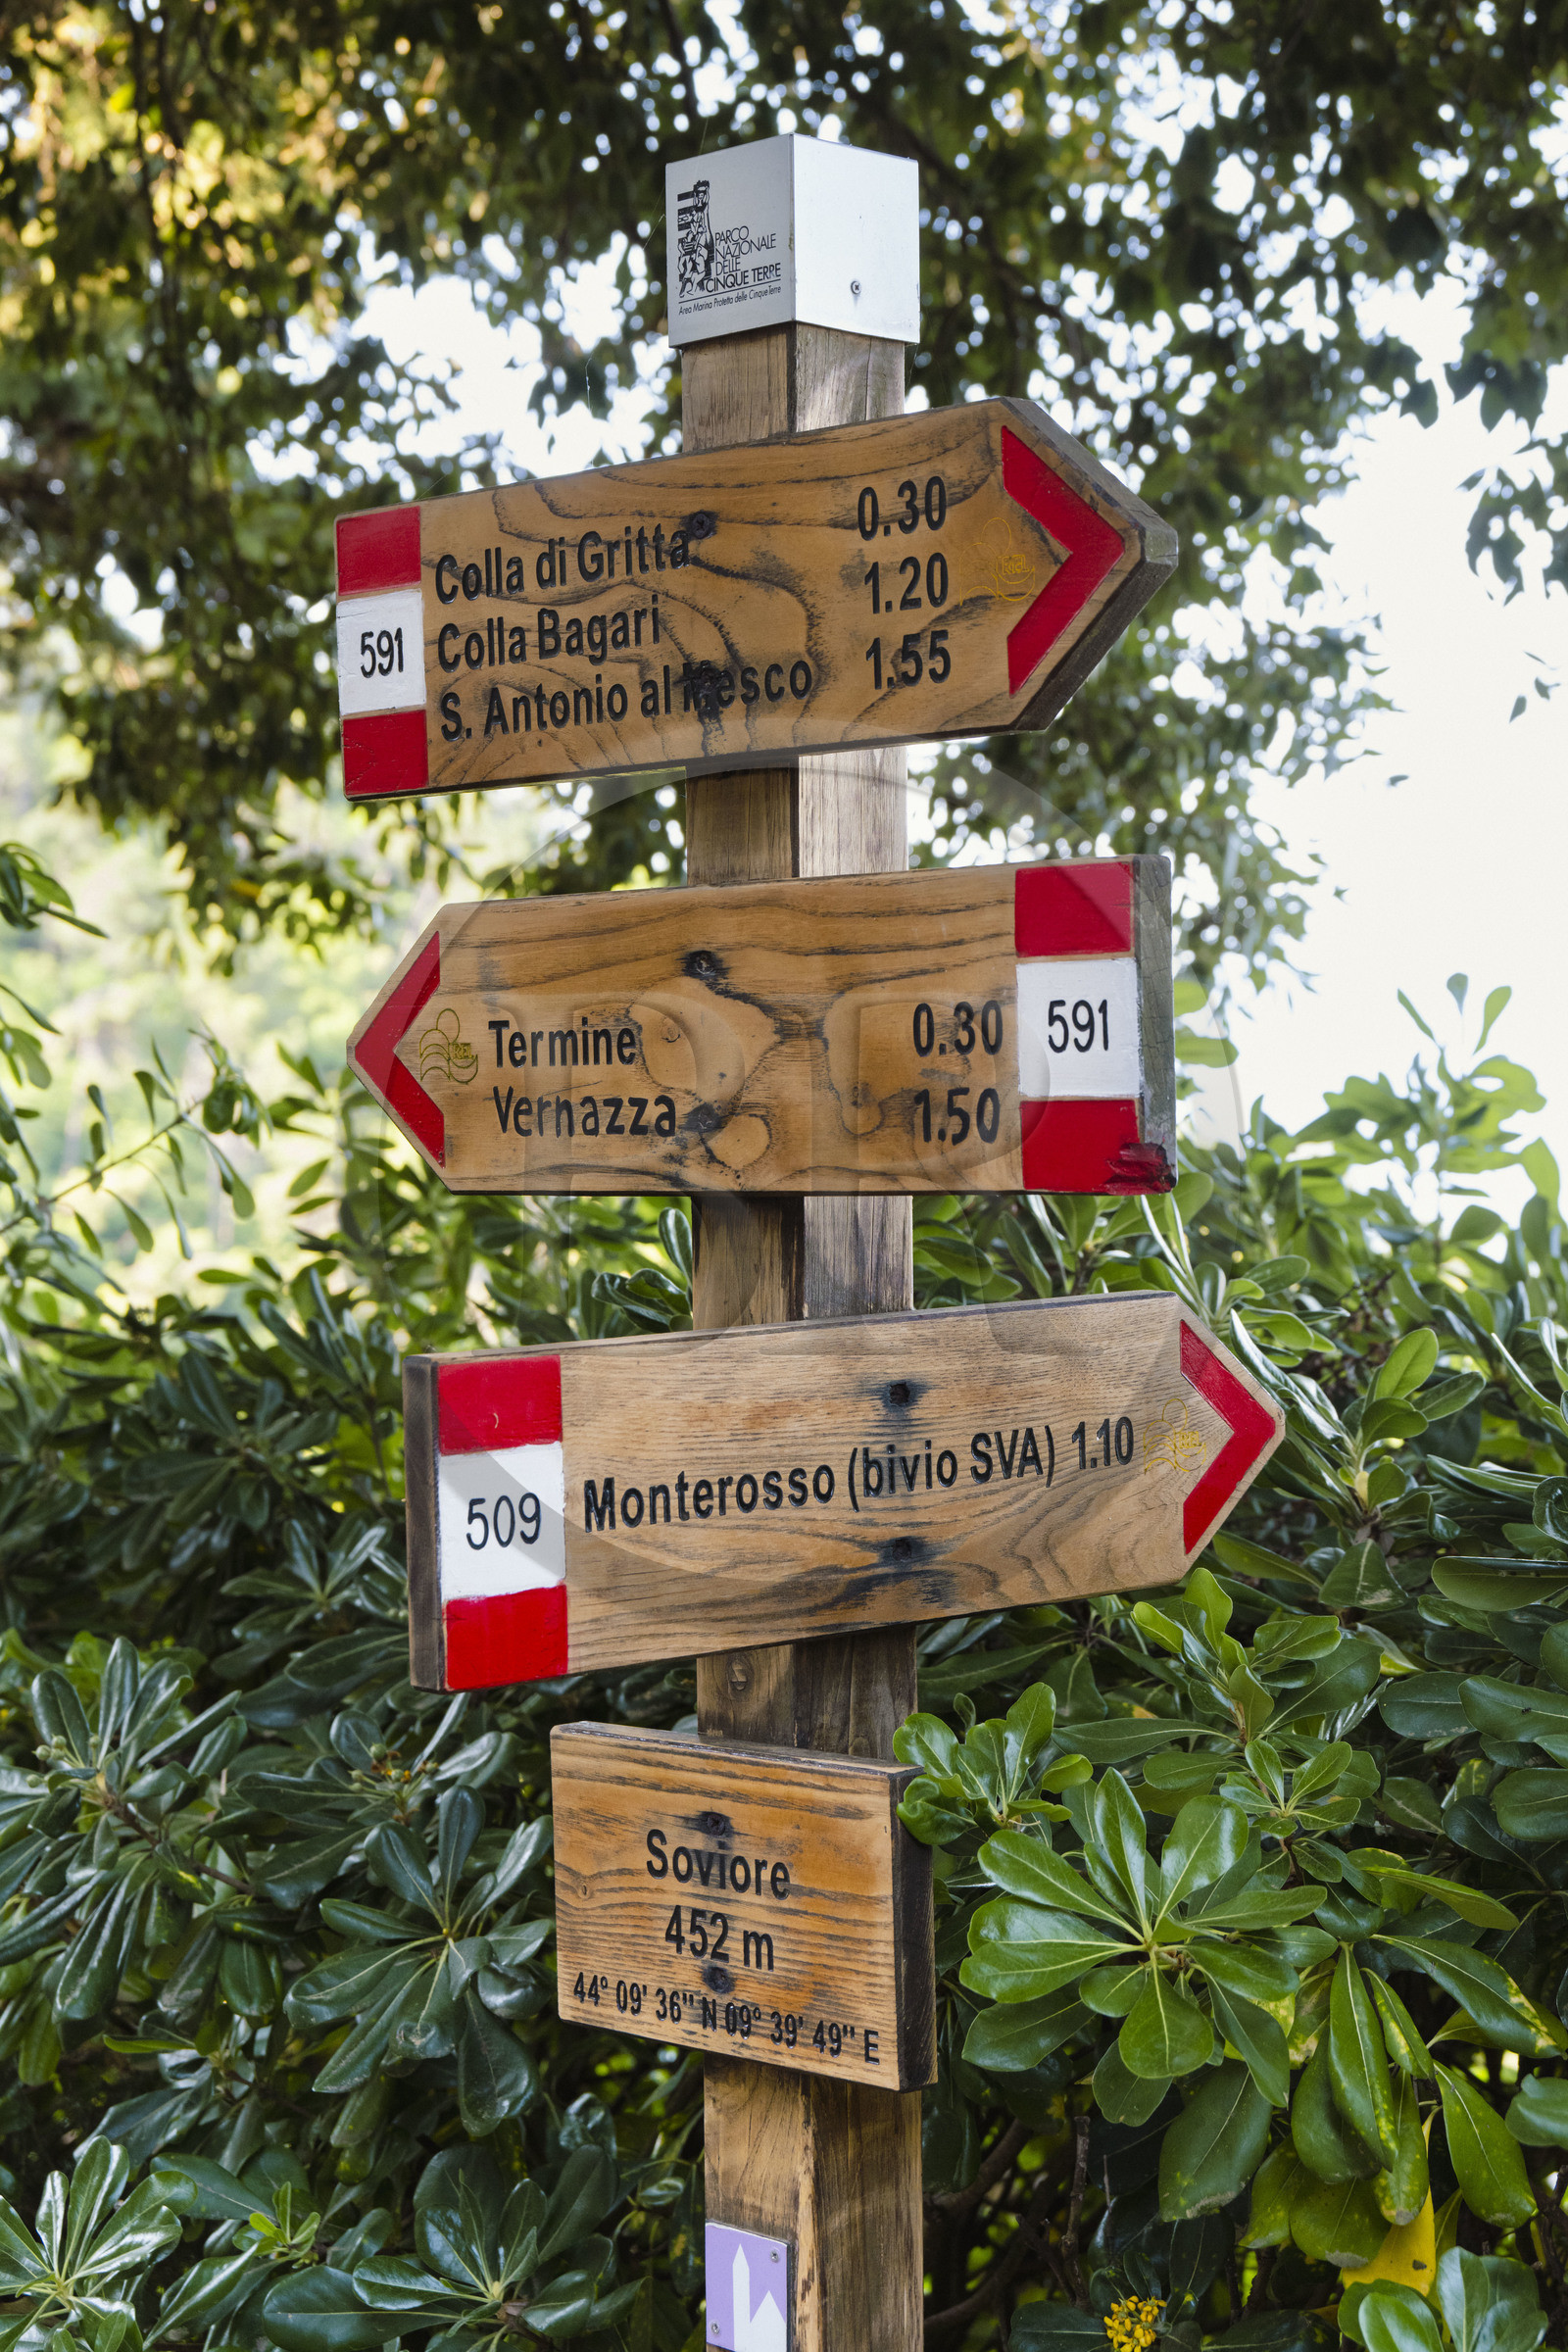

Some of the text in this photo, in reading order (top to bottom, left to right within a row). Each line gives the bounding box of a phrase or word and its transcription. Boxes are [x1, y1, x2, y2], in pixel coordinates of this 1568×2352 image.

[714, 225, 750, 247] PARCO
[714, 233, 777, 262] NAZIONALE
[715, 256, 741, 276] DELLE
[678, 306, 692, 316] Area
[693, 302, 712, 312] Marina
[713, 296, 733, 308] Protetta
[734, 292, 748, 303] delle
[749, 289, 768, 300] Cinque
[705, 263, 781, 293] CINQUE TERRE
[434, 475, 947, 605] Colla di Gritta 0.30
[437, 552, 949, 673] Colla Bagari 1.20
[360, 626, 404, 679] 591
[439, 692, 472, 743] S.
[484, 673, 629, 736] Antonio
[640, 664, 671, 718] al
[865, 629, 951, 691] 1.55
[487, 1000, 1004, 1069] Termine 0.30
[1048, 999, 1109, 1054] 591
[493, 1085, 1001, 1146] Vernazza 1.50
[583, 1416, 1135, 1533] Monterosso (bivio SVA) 1.10
[466, 1492, 542, 1550] 509
[646, 1828, 791, 1901] Soviore
[664, 1904, 774, 1972] 452 m
[573, 1972, 609, 2007] 44°
[615, 1980, 648, 2017] 09'
[702, 1996, 717, 2033] N
[724, 2002, 762, 2040] 09°
[770, 2011, 804, 2049] 39'
[863, 2029, 880, 2066] E
